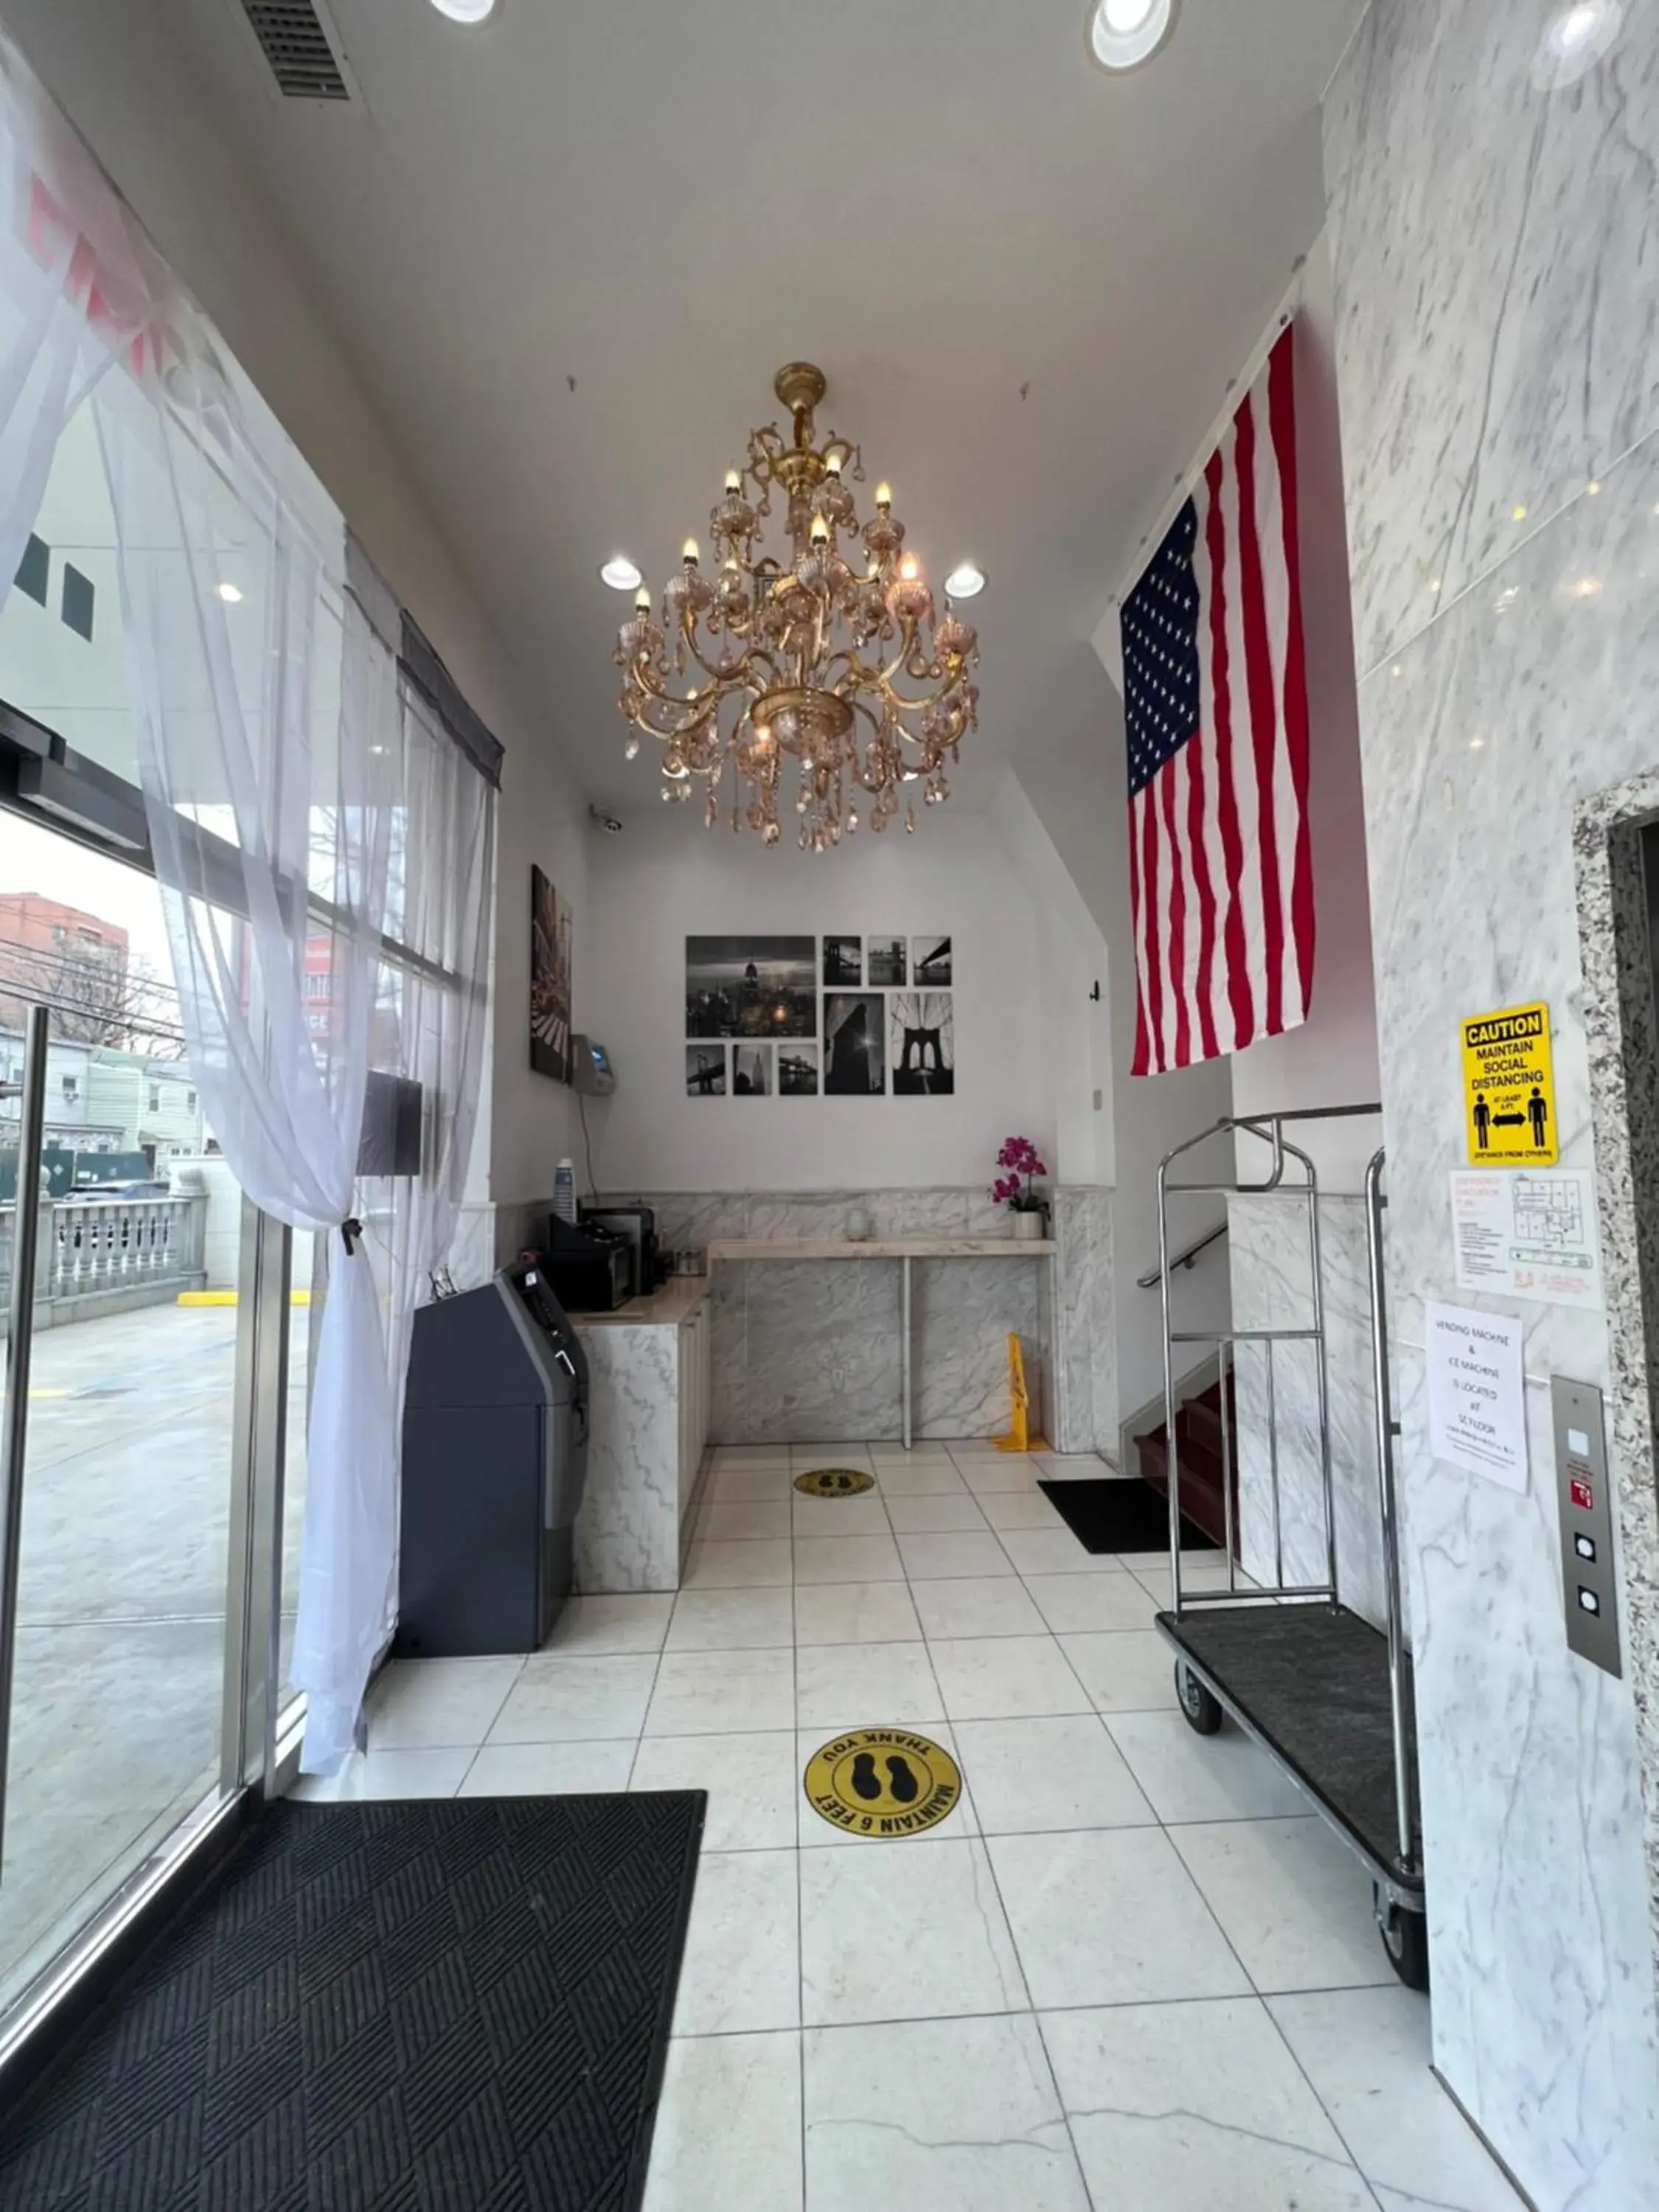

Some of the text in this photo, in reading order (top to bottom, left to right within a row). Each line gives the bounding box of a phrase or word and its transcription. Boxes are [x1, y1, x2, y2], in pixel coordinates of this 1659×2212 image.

[1468, 1015, 1540, 1044] CAUTION
[1477, 1040, 1533, 1060] MAINTAIN
[1484, 1057, 1528, 1074] SOCIAL
[1472, 1070, 1544, 1090] DISTANCING
[1472, 1327, 1509, 1346] MACHINE
[822, 1733, 931, 1762] THANK YOU
[815, 1784, 954, 1832] MAINTAIN 6 FEET
